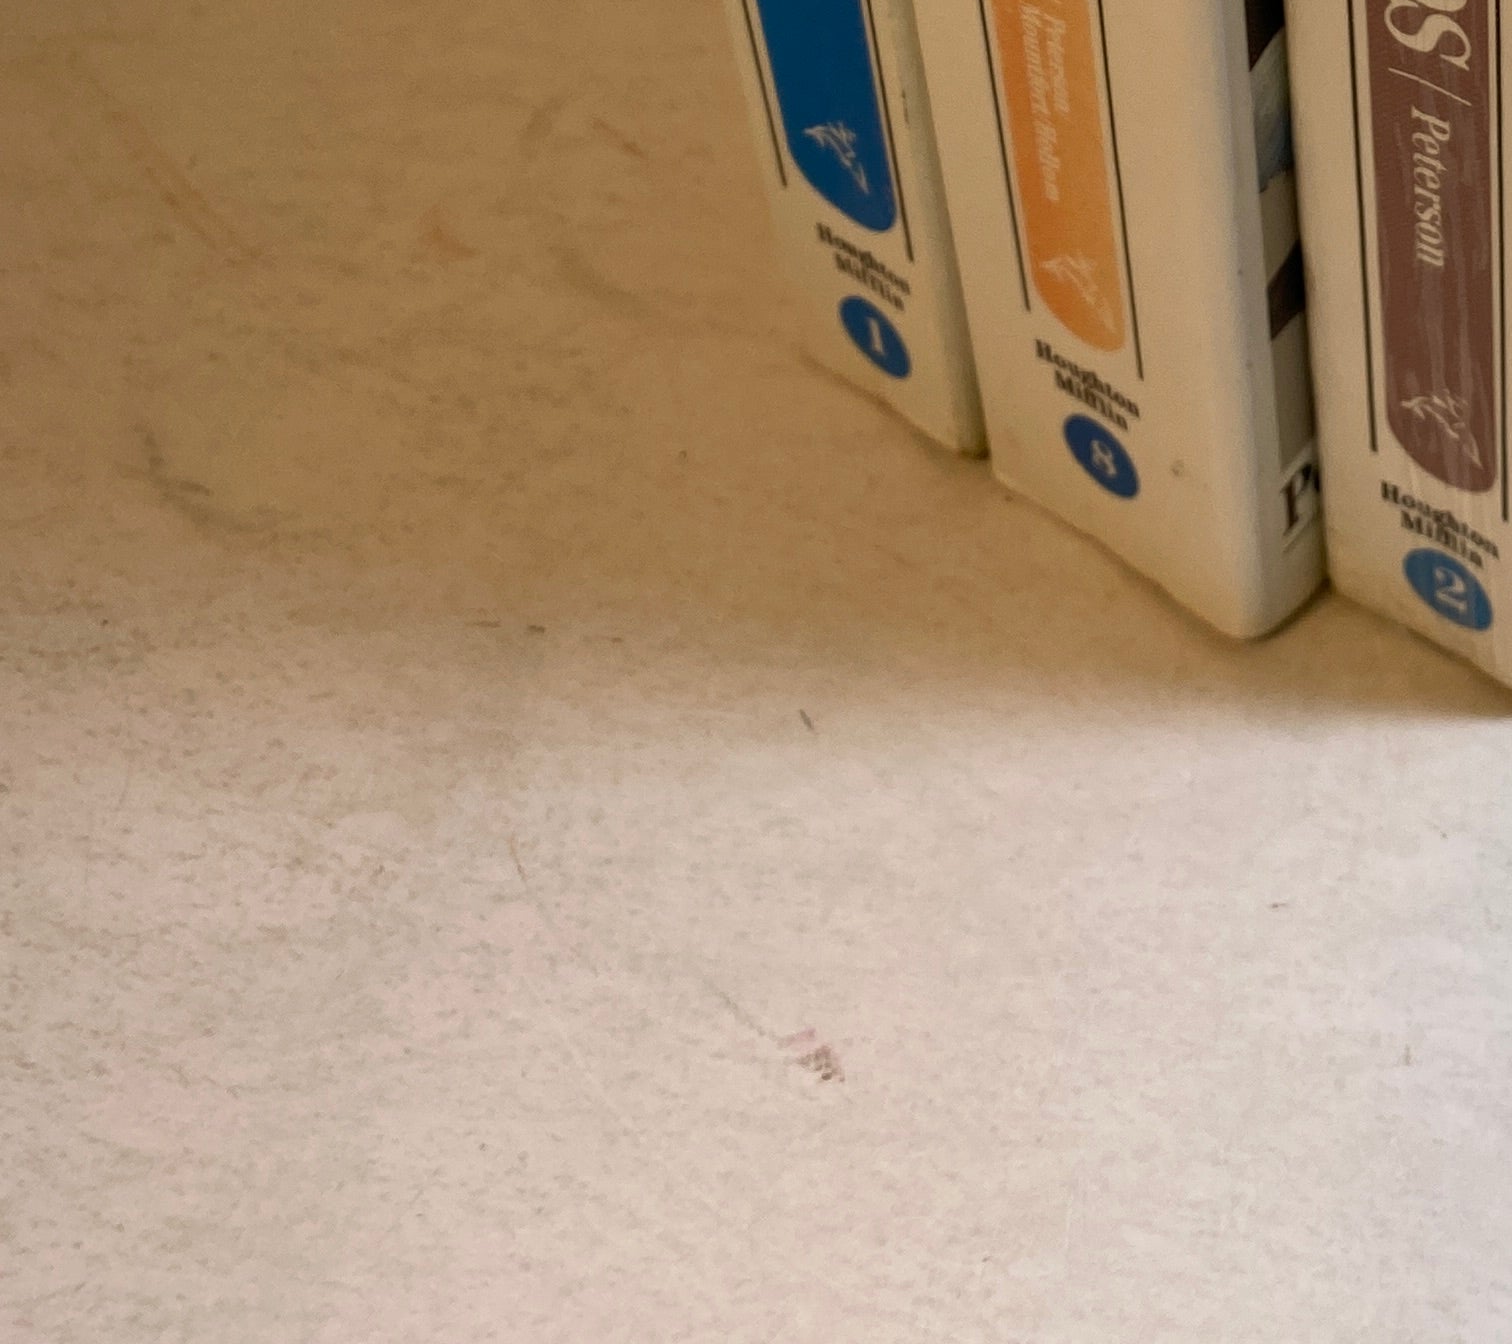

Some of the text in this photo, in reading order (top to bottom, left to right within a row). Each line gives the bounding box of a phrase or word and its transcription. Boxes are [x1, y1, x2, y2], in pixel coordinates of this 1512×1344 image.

[1411, 104, 1451, 267] Peterson
[867, 316, 886, 355] 1
[1035, 338, 1141, 420] Houghton
[1055, 368, 1129, 432] Mifflin
[1090, 438, 1118, 479] 8
[1380, 479, 1500, 560] Houghton
[1434, 565, 1468, 613] 2
